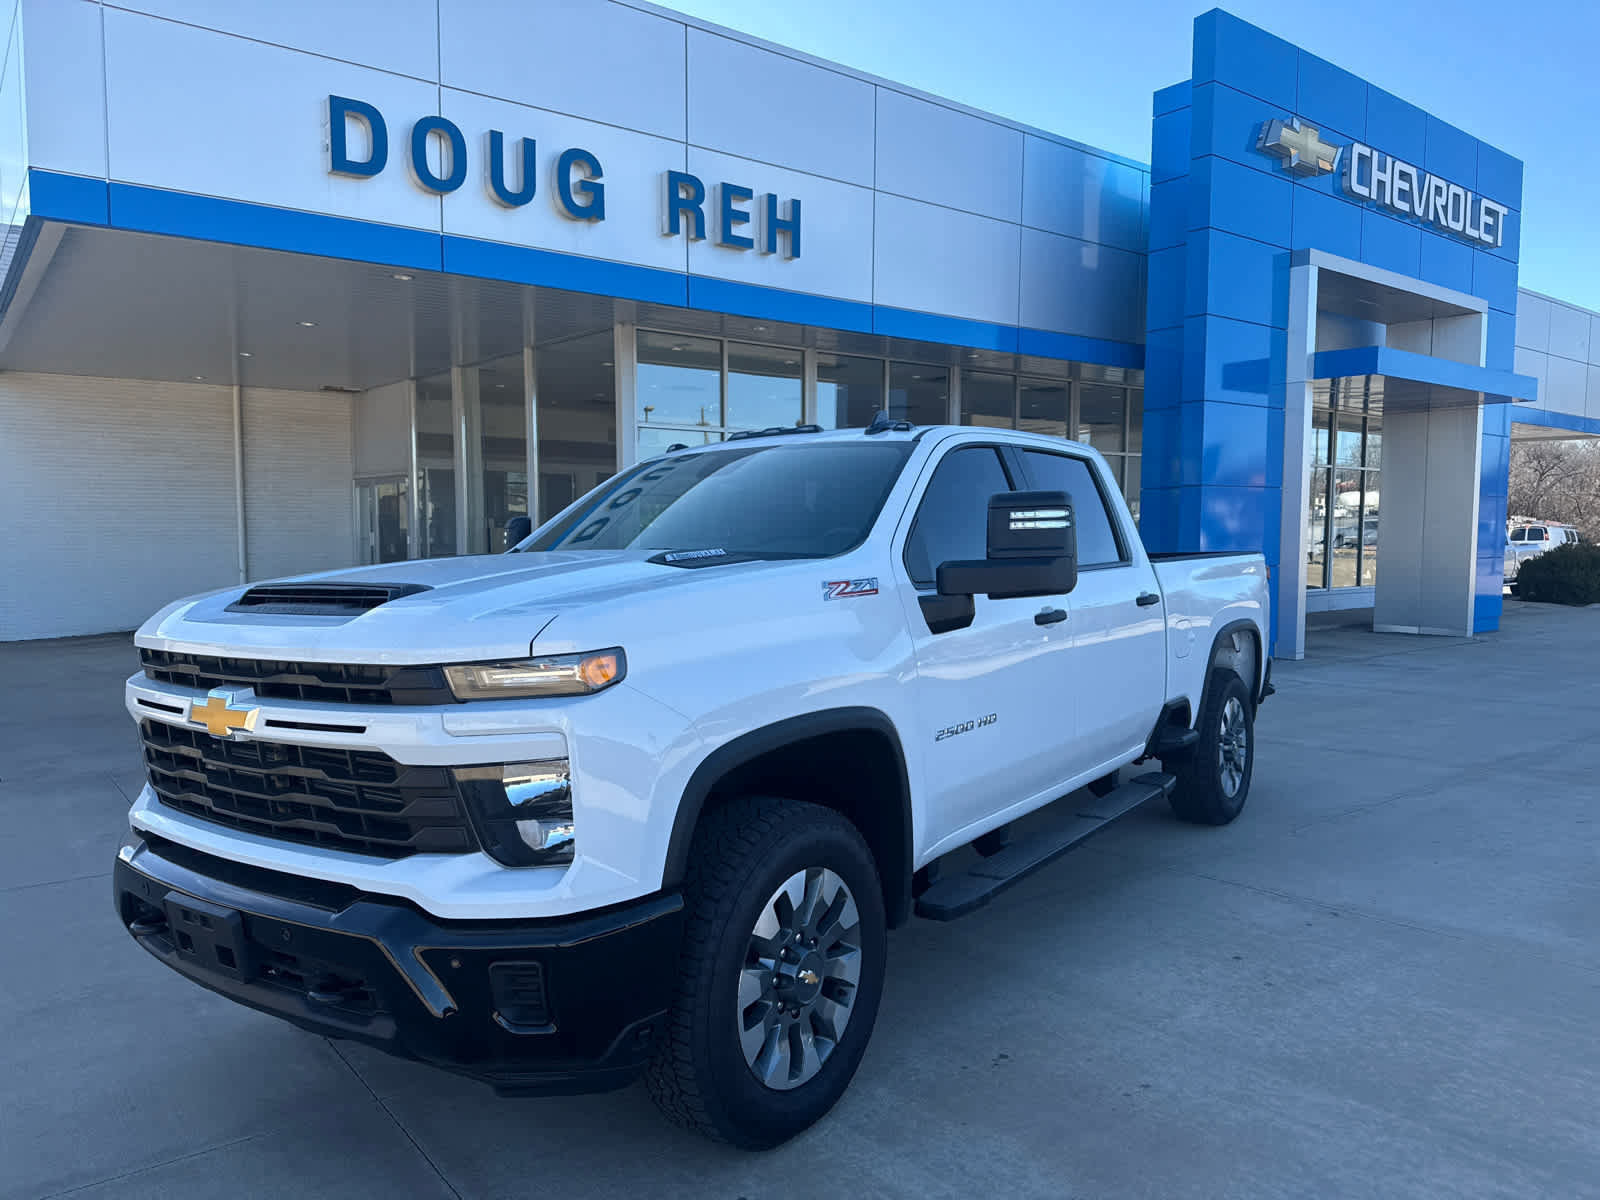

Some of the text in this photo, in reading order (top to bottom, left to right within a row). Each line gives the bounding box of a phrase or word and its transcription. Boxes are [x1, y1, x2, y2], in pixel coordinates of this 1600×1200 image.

[327, 94, 802, 260] DOUG REH
[1349, 141, 1508, 247] CHEVROLET
[823, 577, 879, 601] Z71
[935, 712, 998, 742] 2500 HD
